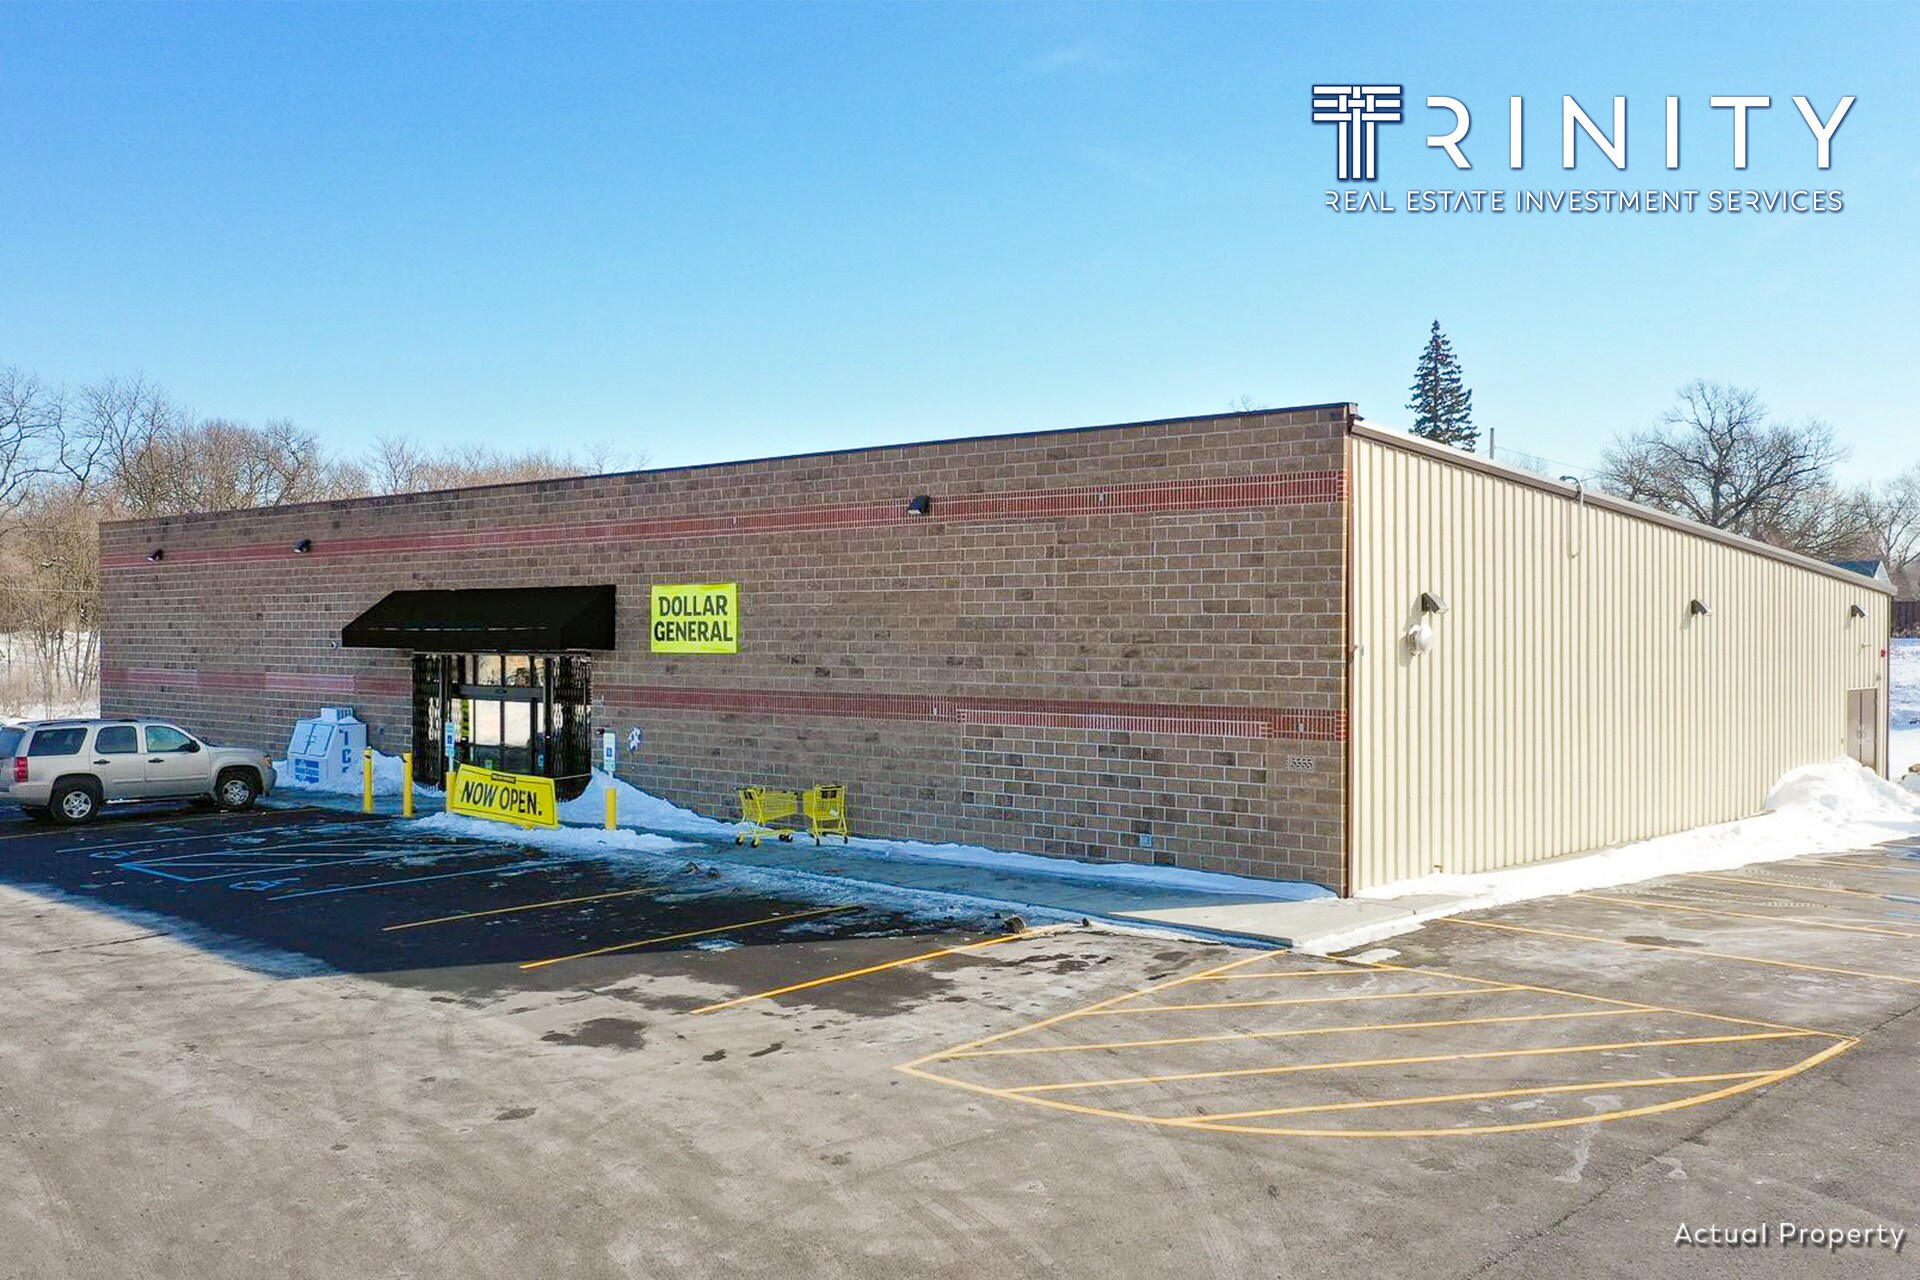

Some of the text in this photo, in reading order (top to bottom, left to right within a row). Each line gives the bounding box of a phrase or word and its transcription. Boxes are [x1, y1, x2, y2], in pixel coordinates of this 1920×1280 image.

[658, 595, 728, 617] DOLLAR
[654, 620, 734, 642] GENERAL
[461, 780, 498, 808] NOW
